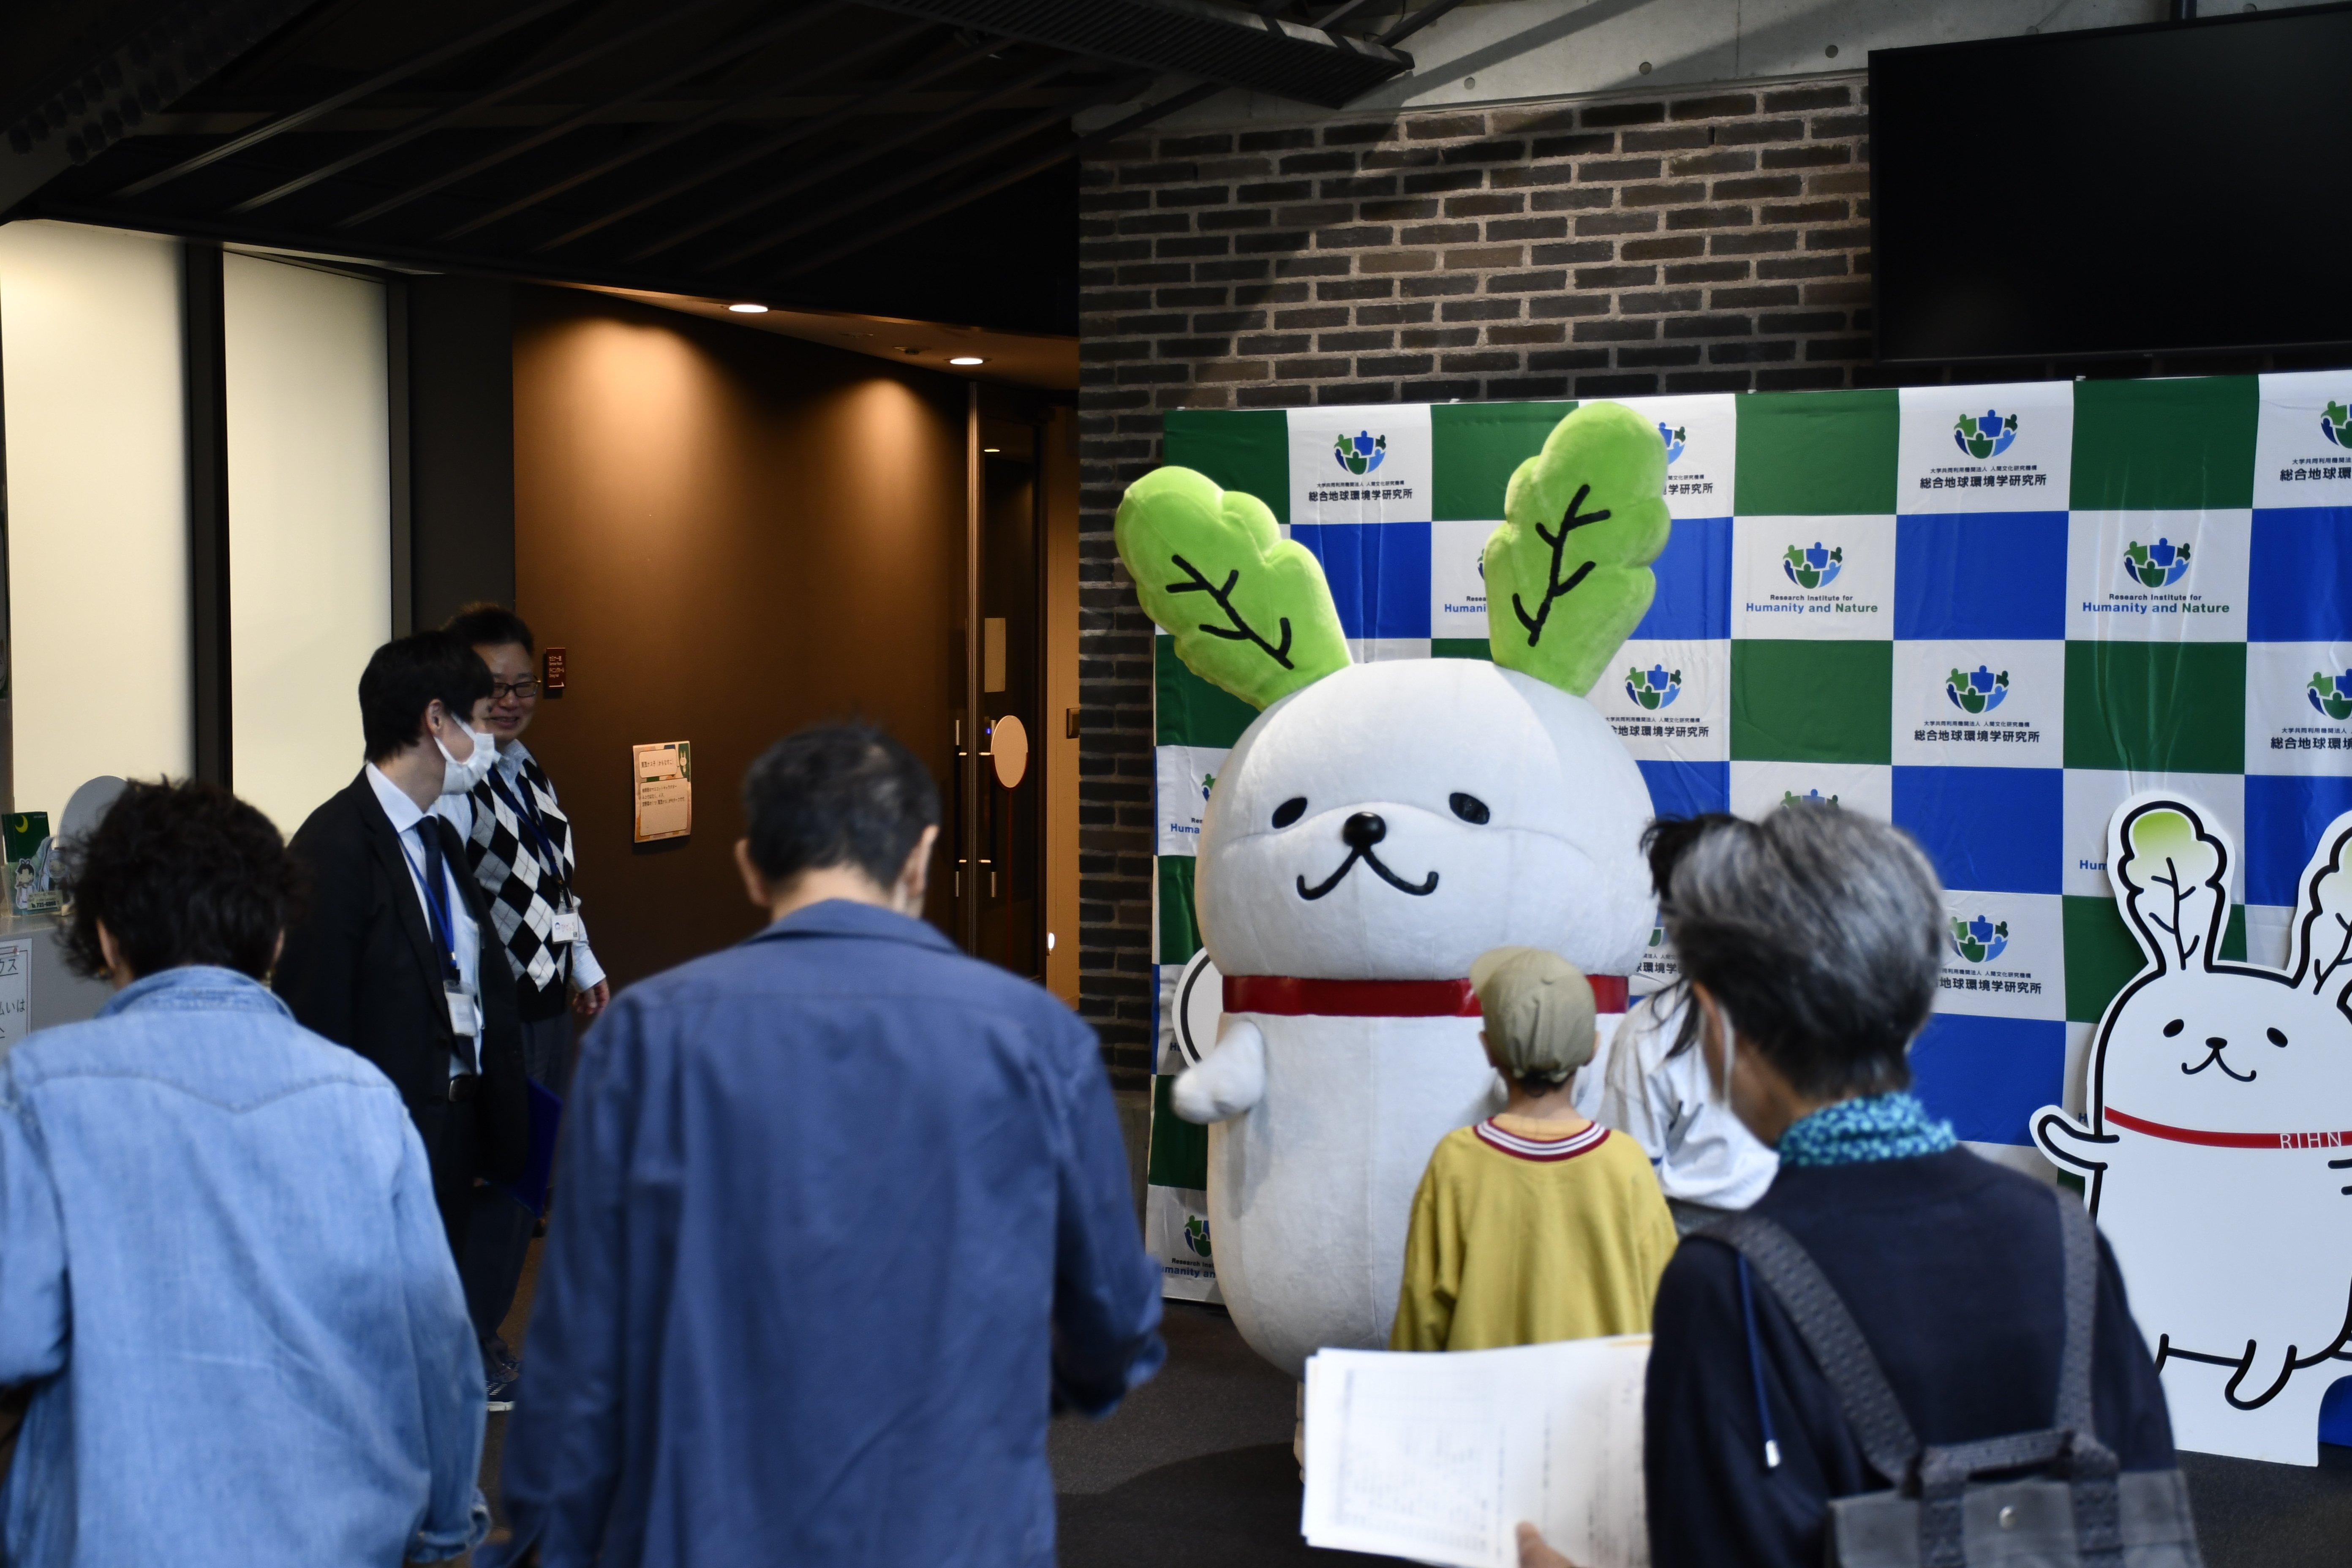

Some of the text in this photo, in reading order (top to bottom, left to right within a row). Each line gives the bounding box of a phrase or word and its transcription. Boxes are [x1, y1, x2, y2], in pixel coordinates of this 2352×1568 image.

[2280, 467, 2352, 482] 総合地球環
[1919, 474, 2047, 489] 総合地球環境学研究所
[1309, 488, 1413, 502] 総合地球環境学研究所
[1746, 603, 1878, 614] Humanity and Nature
[2082, 602, 2230, 614] Humanity and Nature
[1914, 730, 2040, 743] 総合地球環境学研究所
[2280, 1131, 2342, 1149] RIHN
[1172, 1258, 1200, 1266] Research
